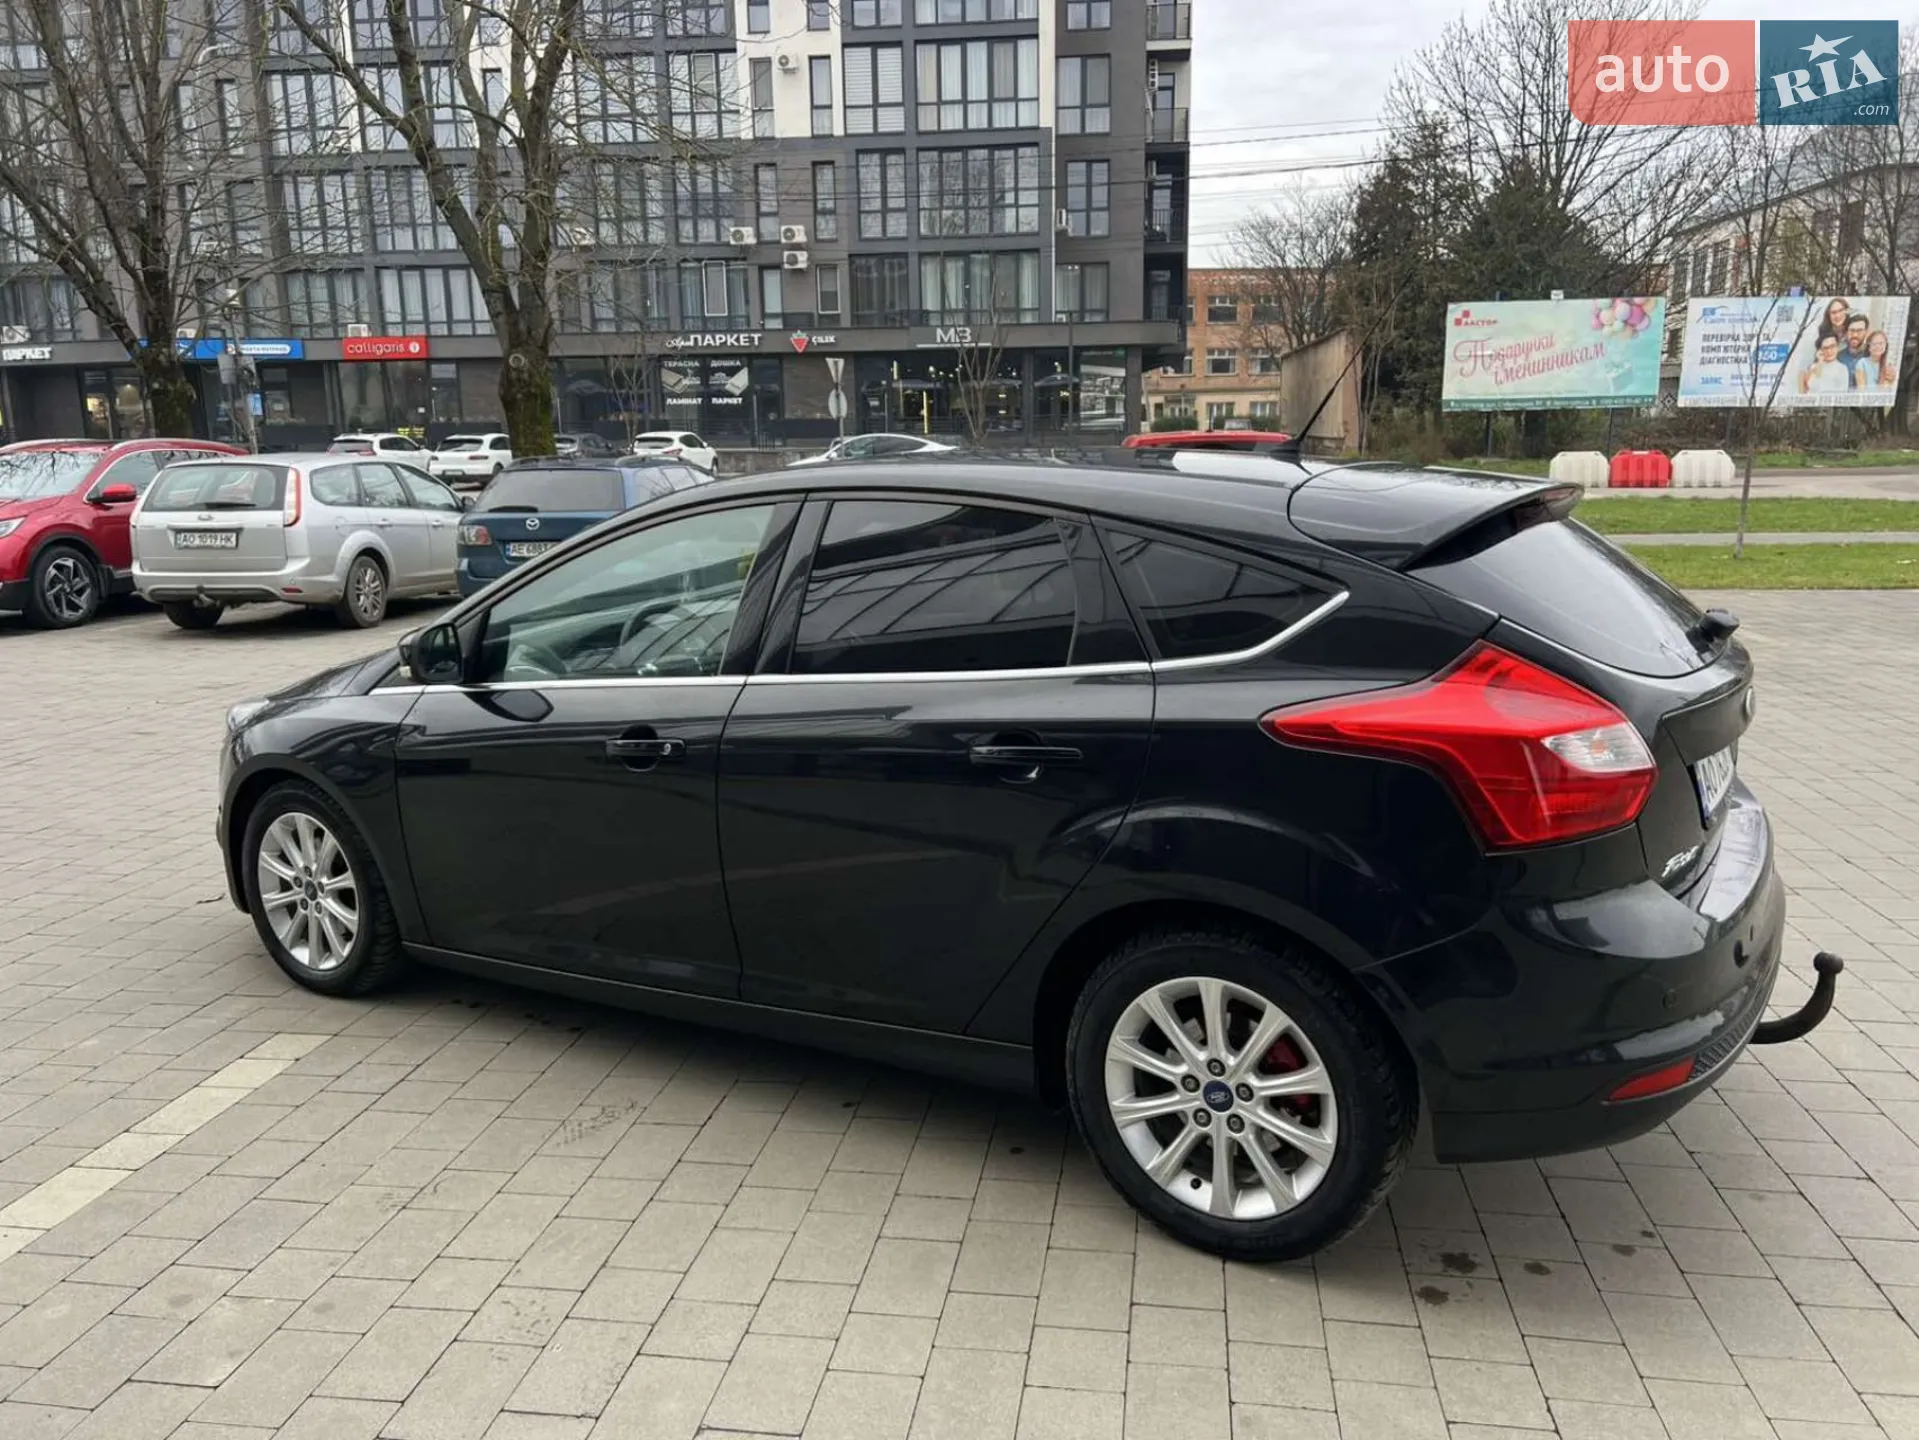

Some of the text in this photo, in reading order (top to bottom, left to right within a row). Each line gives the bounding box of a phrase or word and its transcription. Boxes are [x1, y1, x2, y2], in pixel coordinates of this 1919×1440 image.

[346, 343, 405, 355] calligaris
[1453, 334, 1556, 378] Подарунки
[1493, 341, 1606, 386] іменинникам
